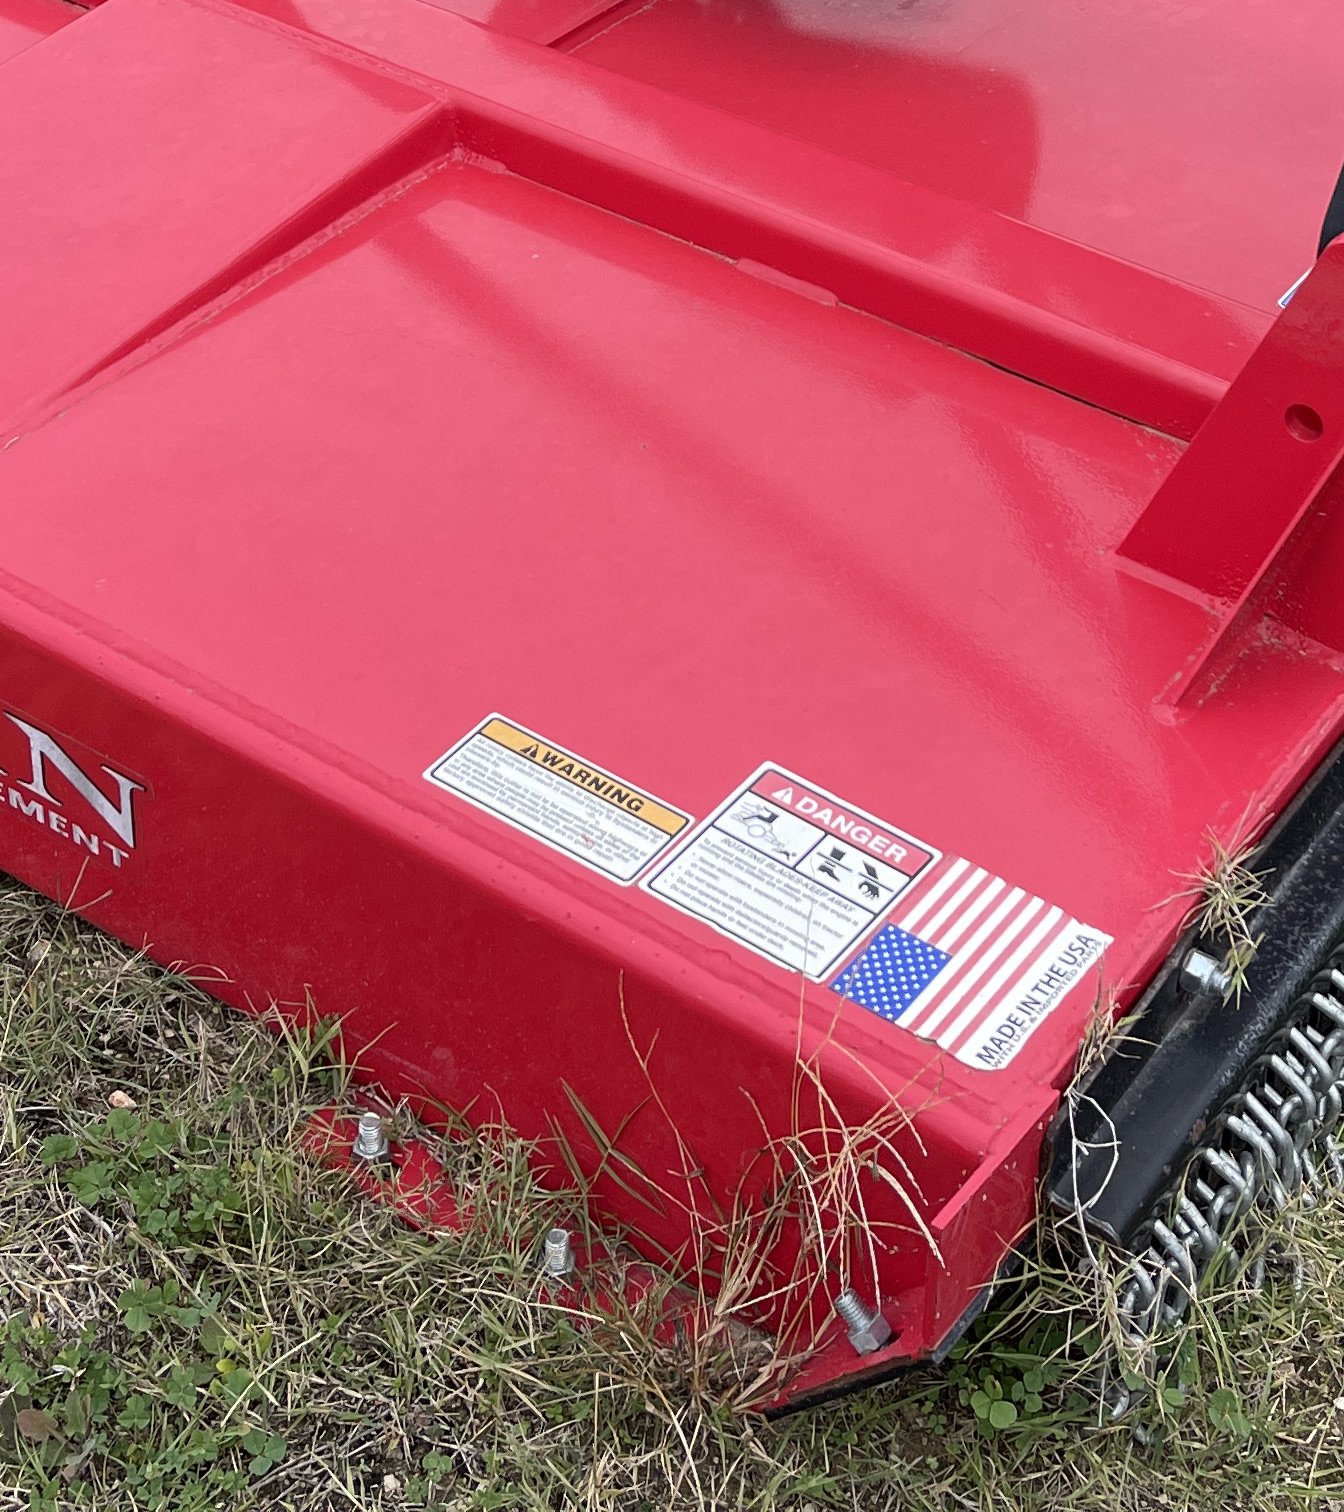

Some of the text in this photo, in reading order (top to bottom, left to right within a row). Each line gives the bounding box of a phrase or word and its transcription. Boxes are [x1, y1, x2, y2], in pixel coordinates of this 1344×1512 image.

[541, 751, 645, 813] WARNING
[795, 795, 908, 864] DANGER
[975, 934, 1095, 1064] MADE IN THE USA
